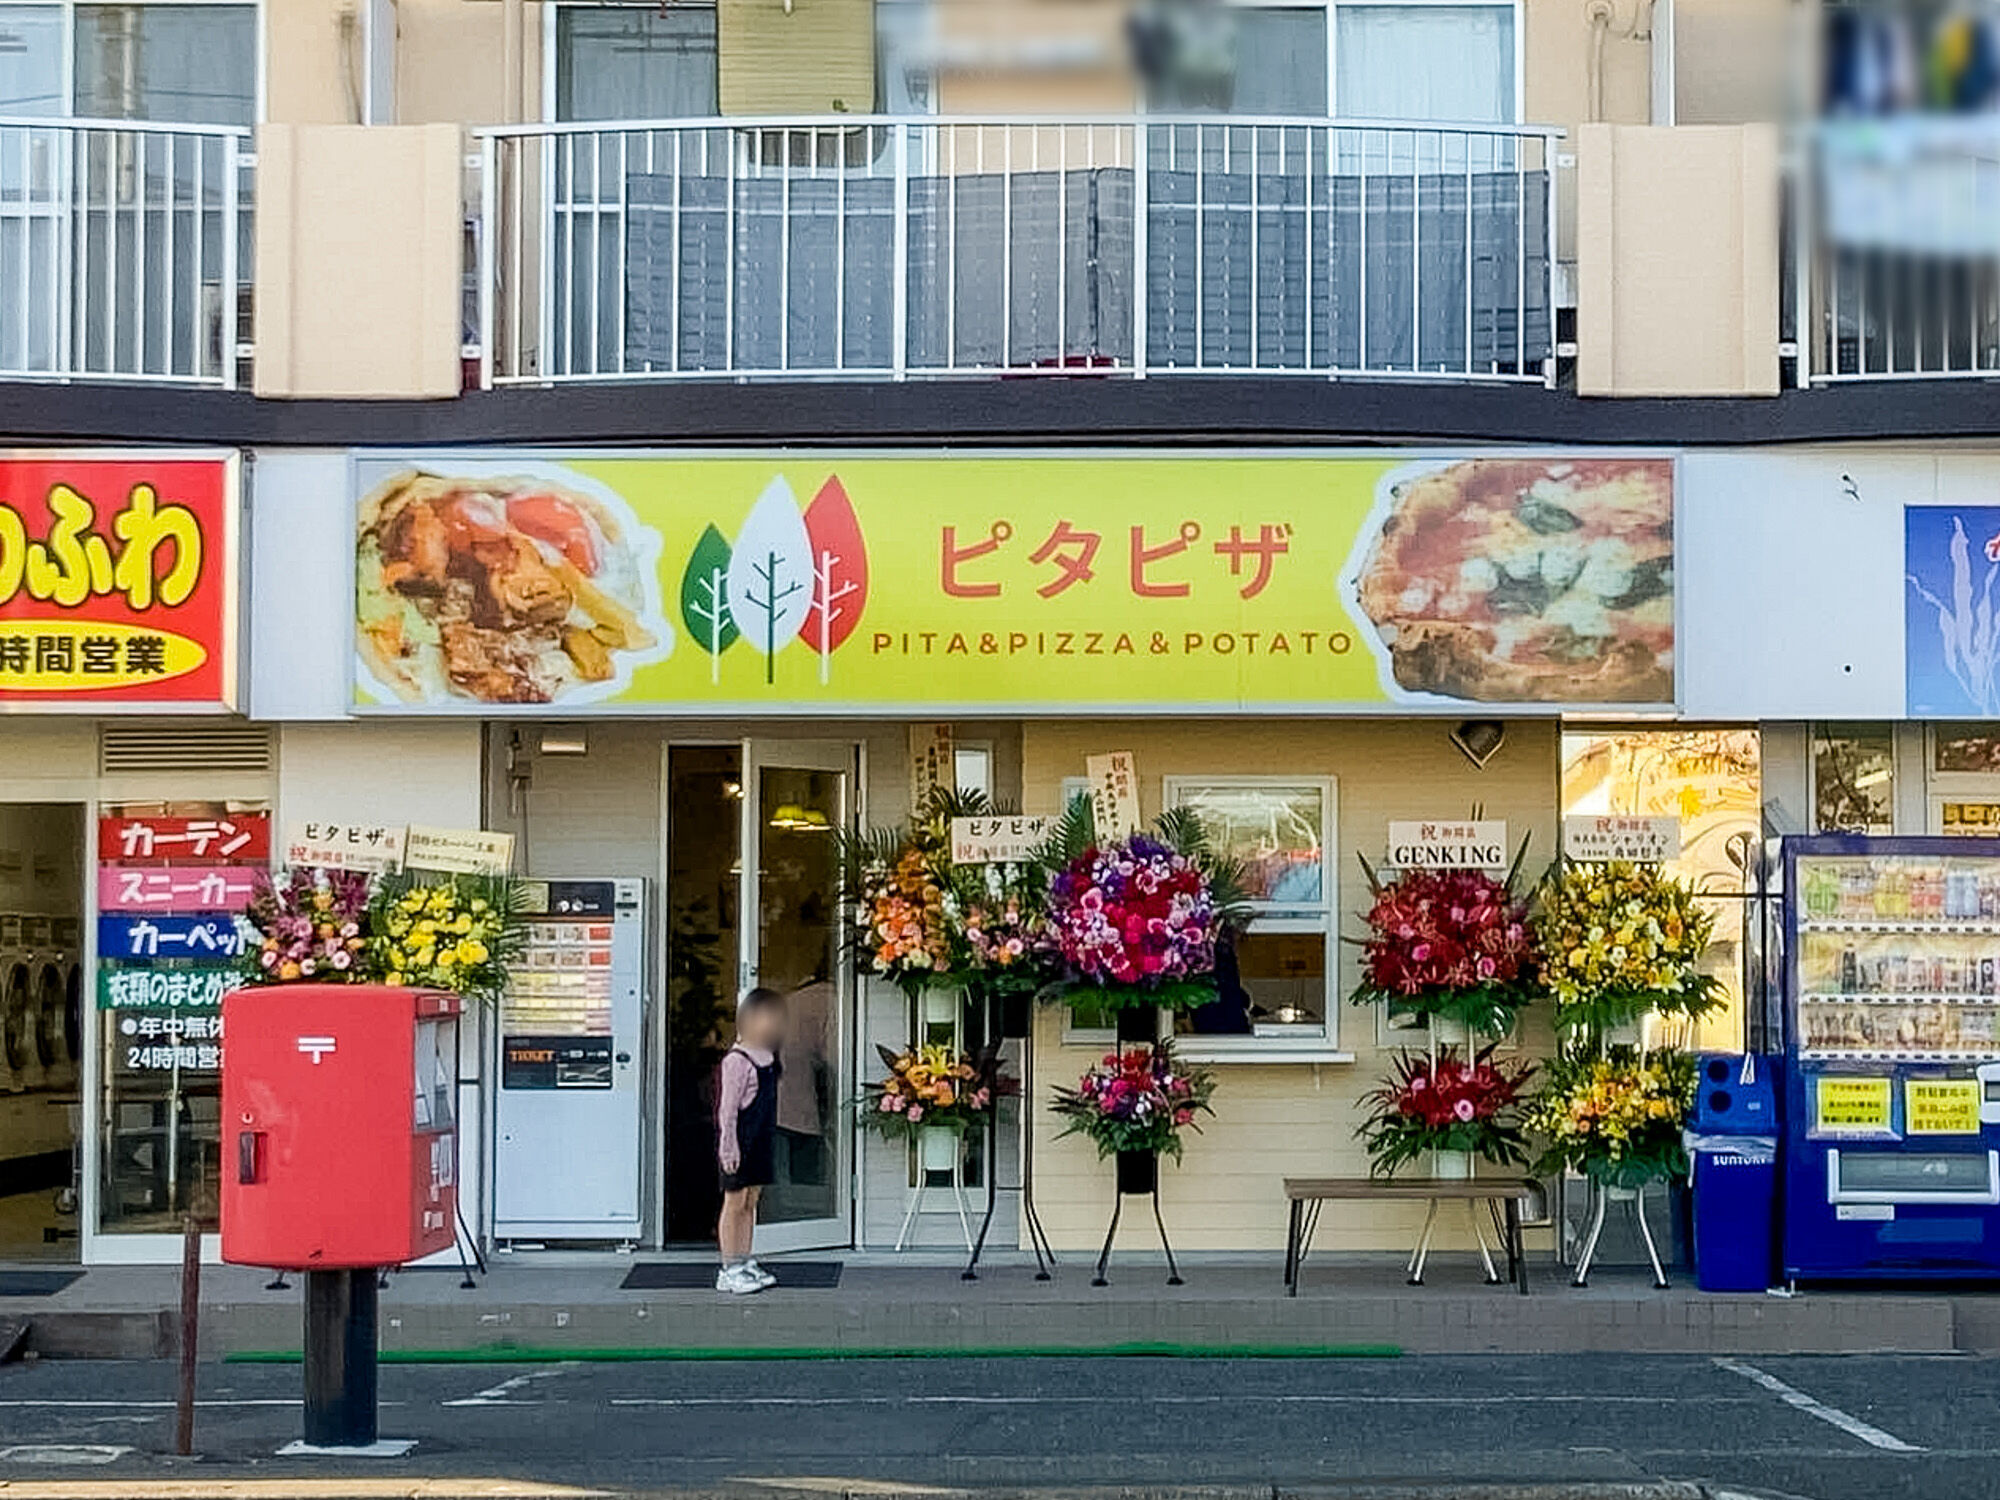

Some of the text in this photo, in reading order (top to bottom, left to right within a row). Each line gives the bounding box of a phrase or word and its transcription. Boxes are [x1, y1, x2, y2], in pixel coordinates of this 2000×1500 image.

[941, 520, 1293, 600] ピタピザ
[0, 635, 166, 674] 時間営業
[120, 822, 252, 856] カーテン
[1394, 845, 1501, 864] GENKING
[119, 872, 253, 904] スニーカー
[127, 1047, 225, 1069] 24時間営
